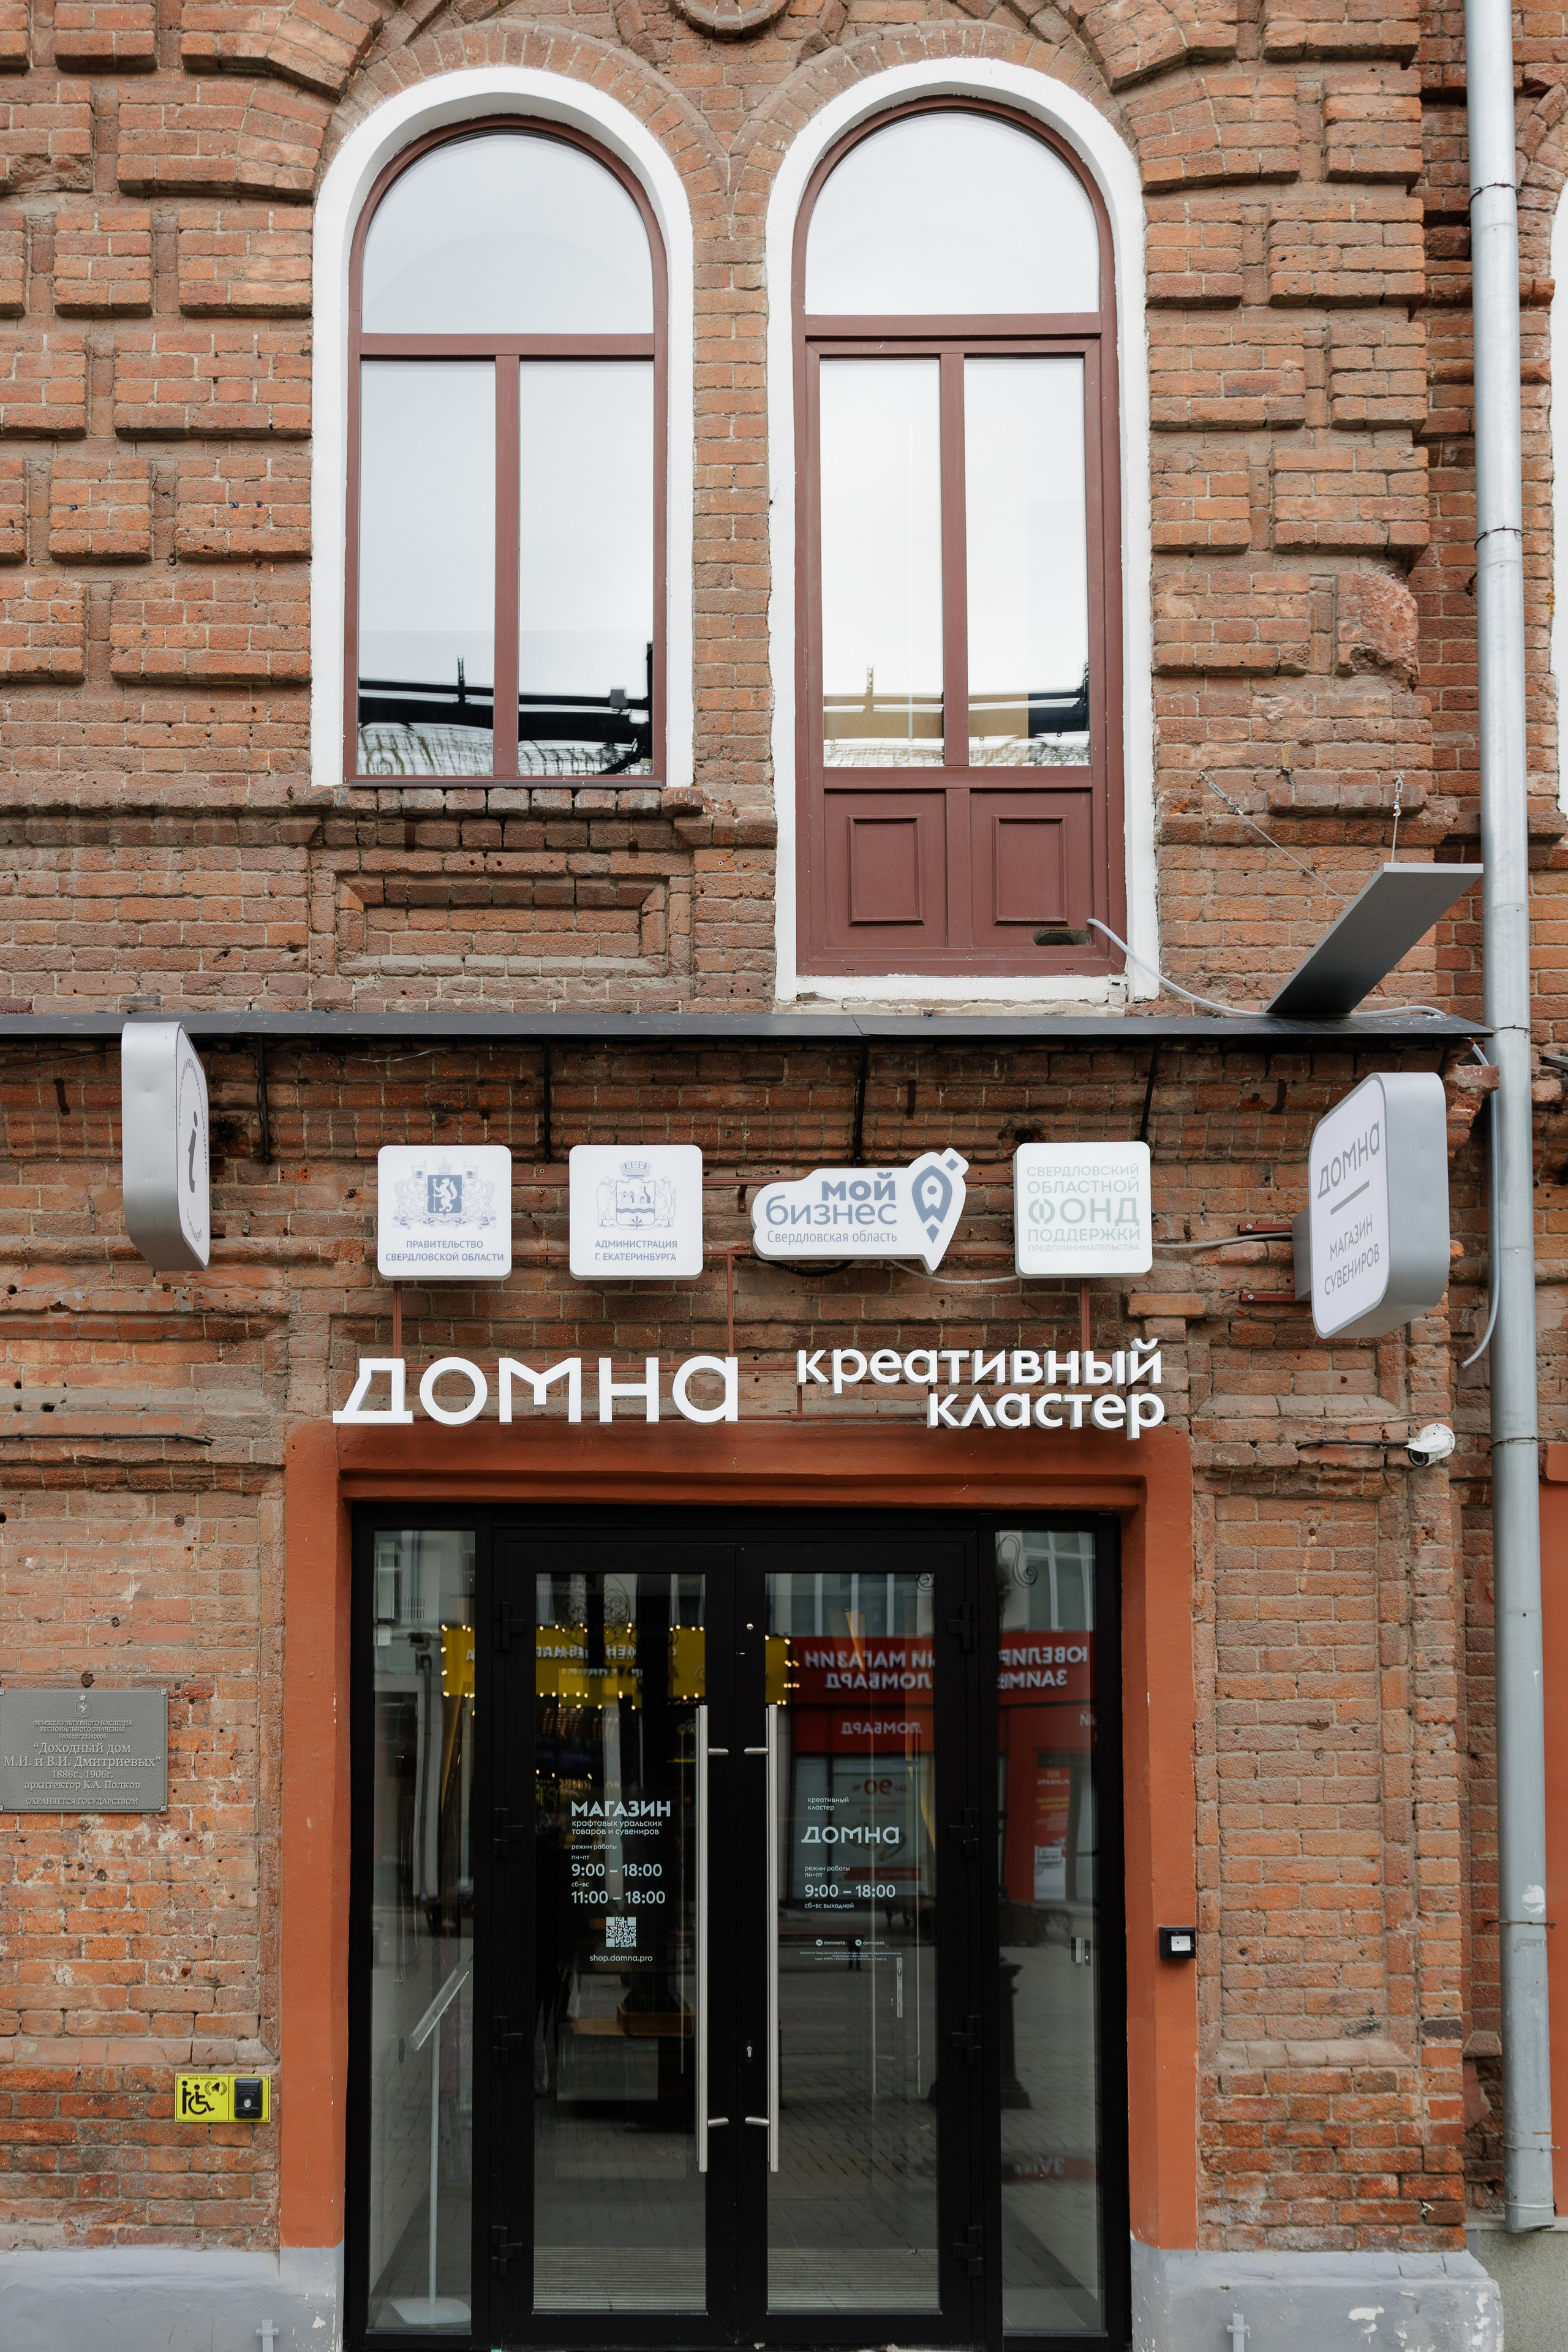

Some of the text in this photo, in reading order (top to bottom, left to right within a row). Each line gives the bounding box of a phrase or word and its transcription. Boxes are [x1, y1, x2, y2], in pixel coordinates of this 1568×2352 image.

[1027, 1163, 1139, 1177] СВЕРДЛОВСКИЙ
[822, 1172, 895, 1201] мой
[1027, 1176, 1139, 1194] ОБЛАСТНОЙ
[766, 1194, 897, 1226] бизнес
[1028, 1197, 1140, 1227] ФОНД
[767, 1230, 897, 1245] Свердловская область
[1028, 1228, 1140, 1243] ПОДДЕРЖКИ
[1330, 1213, 1373, 1261] МАГАЗИН
[406, 1240, 483, 1249] ПРАВИТЕЛЬСТВО
[595, 1240, 678, 1250] АДМИНИСТРАЦИЯ
[386, 1252, 504, 1262] СВЕРДЛОВСКОЙ ОБЛАСТИ
[1324, 1243, 1379, 1296] СУВЕНИРОВ
[797, 1338, 1163, 1395] креативный
[927, 1392, 1166, 1441] кластер
[107, 1745, 132, 1755] дом
[4, 1757, 31, 1766] М.И.
[47, 1757, 71, 1766] В.И.
[52, 1770, 113, 1779] 1886г., 1906г.
[24, 1781, 140, 1791] архитектор К.А. Полков
[571, 1800, 671, 1817] МАГАЗИН
[619, 1820, 662, 1828] уральских
[571, 1863, 605, 1877] 9:00
[622, 1863, 662, 1877] 18:00
[571, 1891, 608, 1904] 11:00
[625, 1891, 665, 1904] 18:00
[804, 1884, 839, 1898] 9:00
[855, 1884, 896, 1898] 18:00
[589, 1954, 653, 1962] shop.domna.pro
